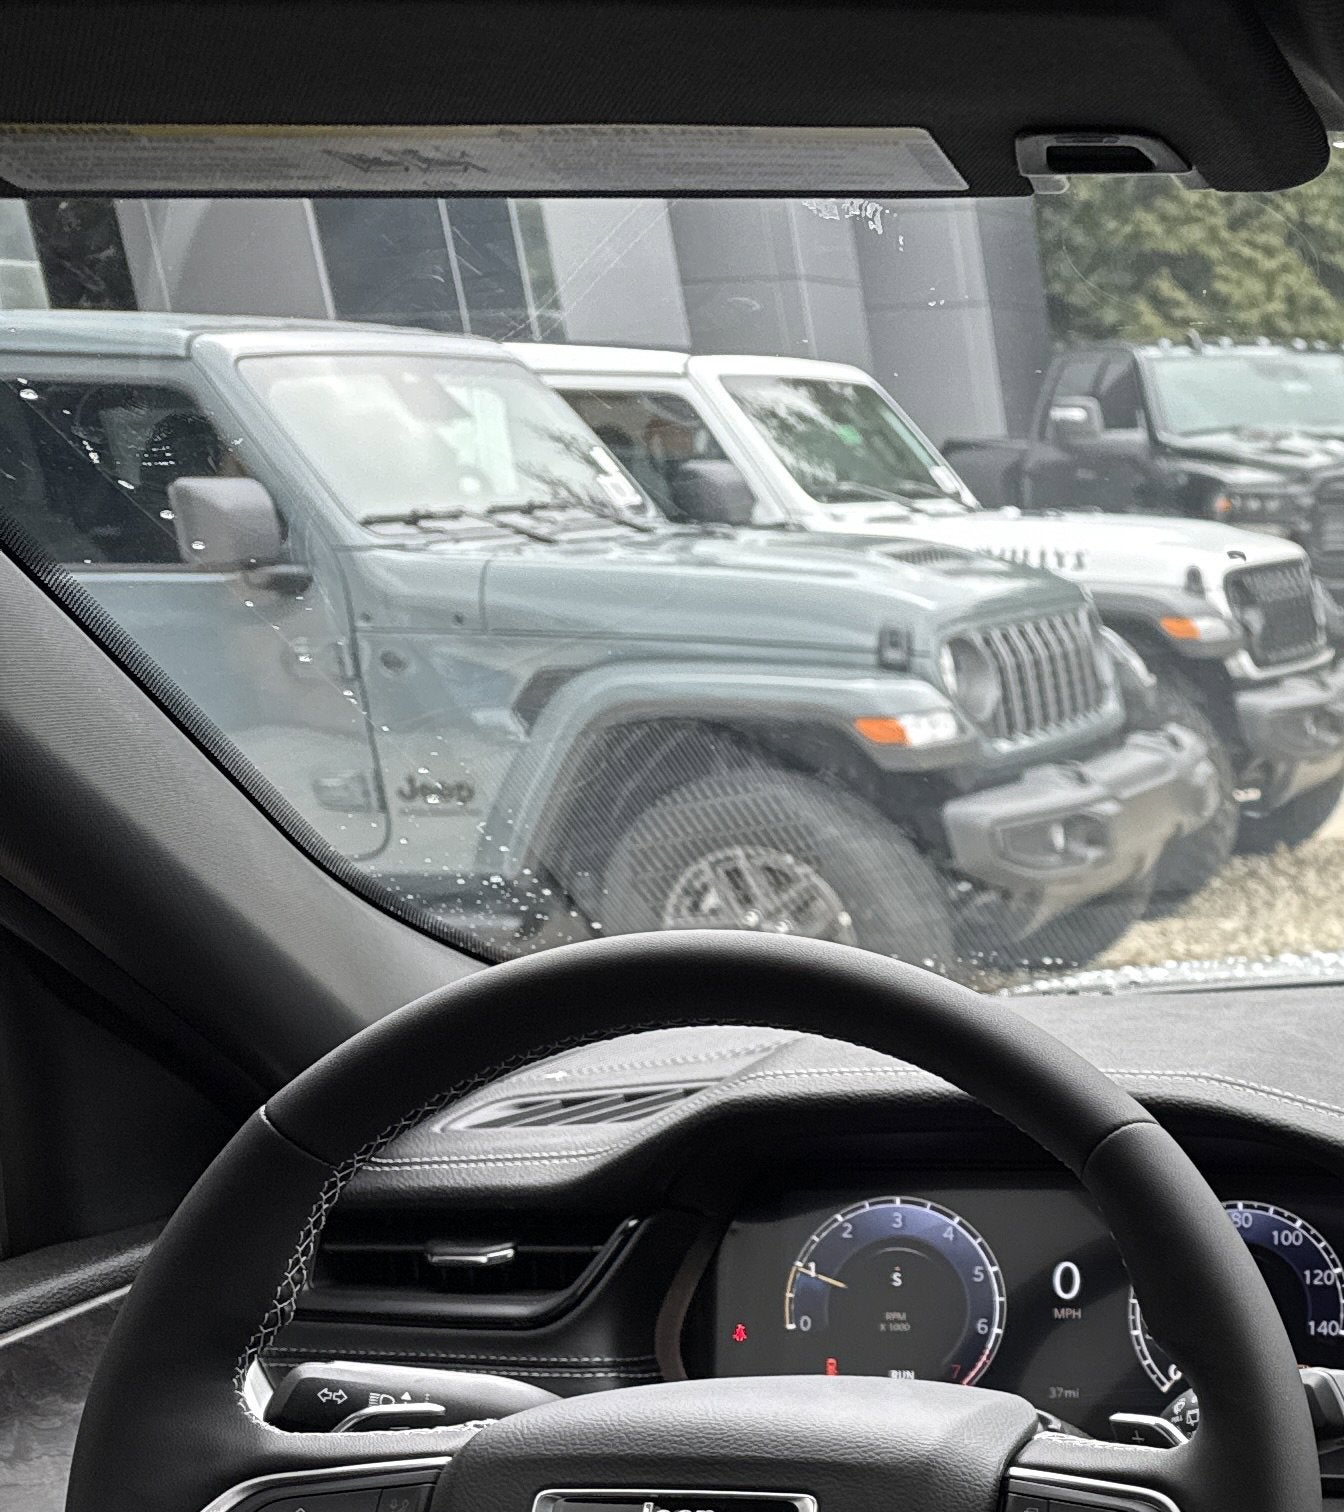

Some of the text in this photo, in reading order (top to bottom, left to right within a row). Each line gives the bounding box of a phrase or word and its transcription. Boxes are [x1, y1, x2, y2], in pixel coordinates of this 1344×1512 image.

[892, 1213, 902, 1228] 3
[1232, 1213, 1252, 1228] 80
[842, 1223, 852, 1238] 2
[942, 1227, 954, 1241] 4
[1272, 1230, 1302, 1246] 100
[890, 1273, 902, 1286] S
[974, 1266, 984, 1282] 5
[1053, 1261, 1080, 1299] 0
[1304, 1270, 1334, 1285] 120
[1054, 1308, 1081, 1319] MPH
[800, 1316, 811, 1331] 0
[977, 1319, 988, 1334] 6
[1309, 1321, 1339, 1336] 140
[952, 1365, 960, 1378] 7
[1050, 1387, 1079, 1398] 37mi
